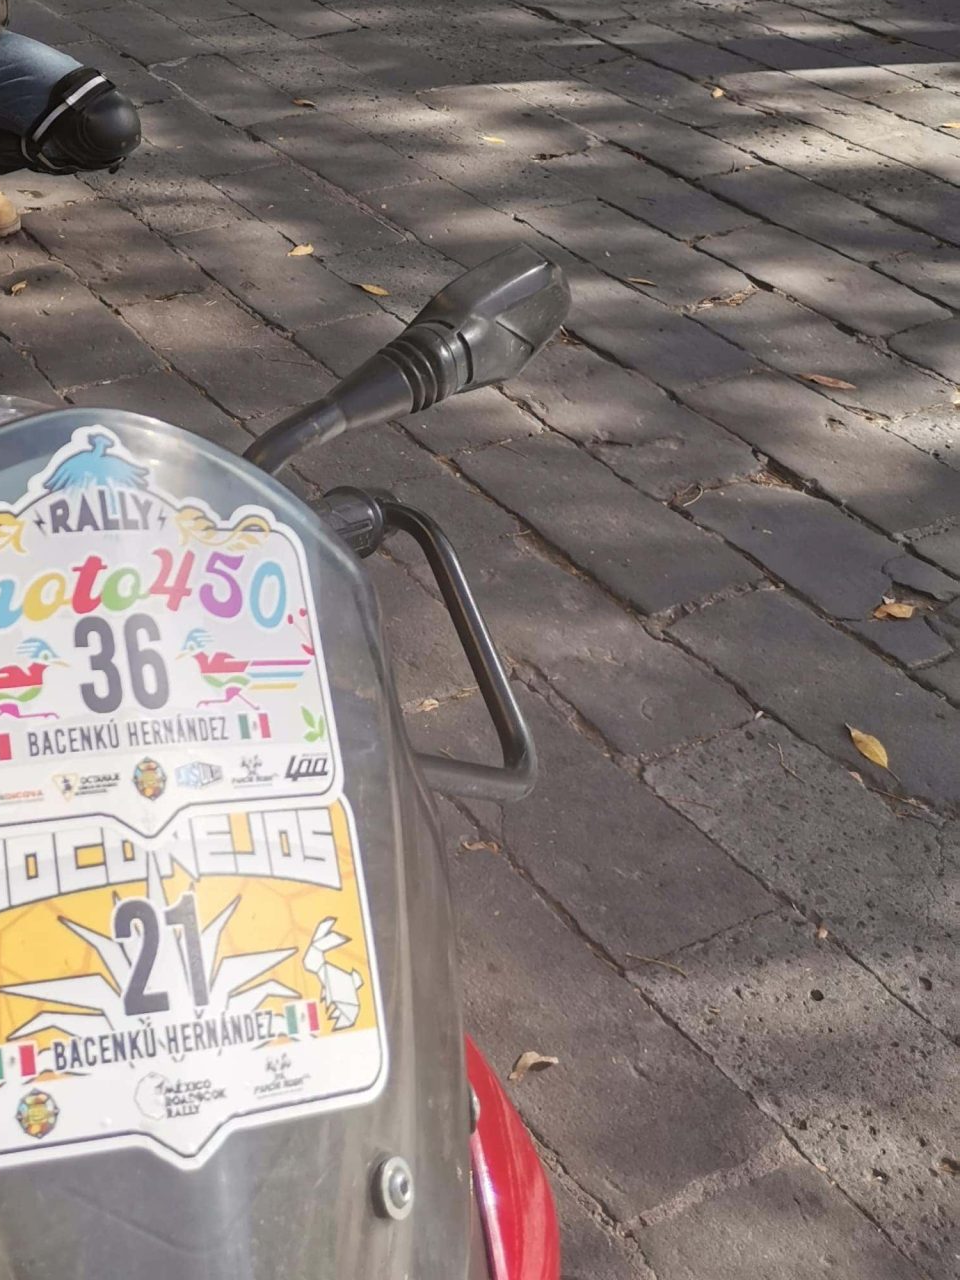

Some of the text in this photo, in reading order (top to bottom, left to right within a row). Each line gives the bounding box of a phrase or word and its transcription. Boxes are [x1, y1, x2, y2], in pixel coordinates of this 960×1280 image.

[50, 488, 155, 534] RALLY
[73, 613, 170, 714] 36
[26, 714, 230, 758] BACENKÚ HERNÁNDEZ
[114, 891, 210, 1018] 21
[52, 1010, 276, 1071] BACENKÚ HERNÁNDEZ
